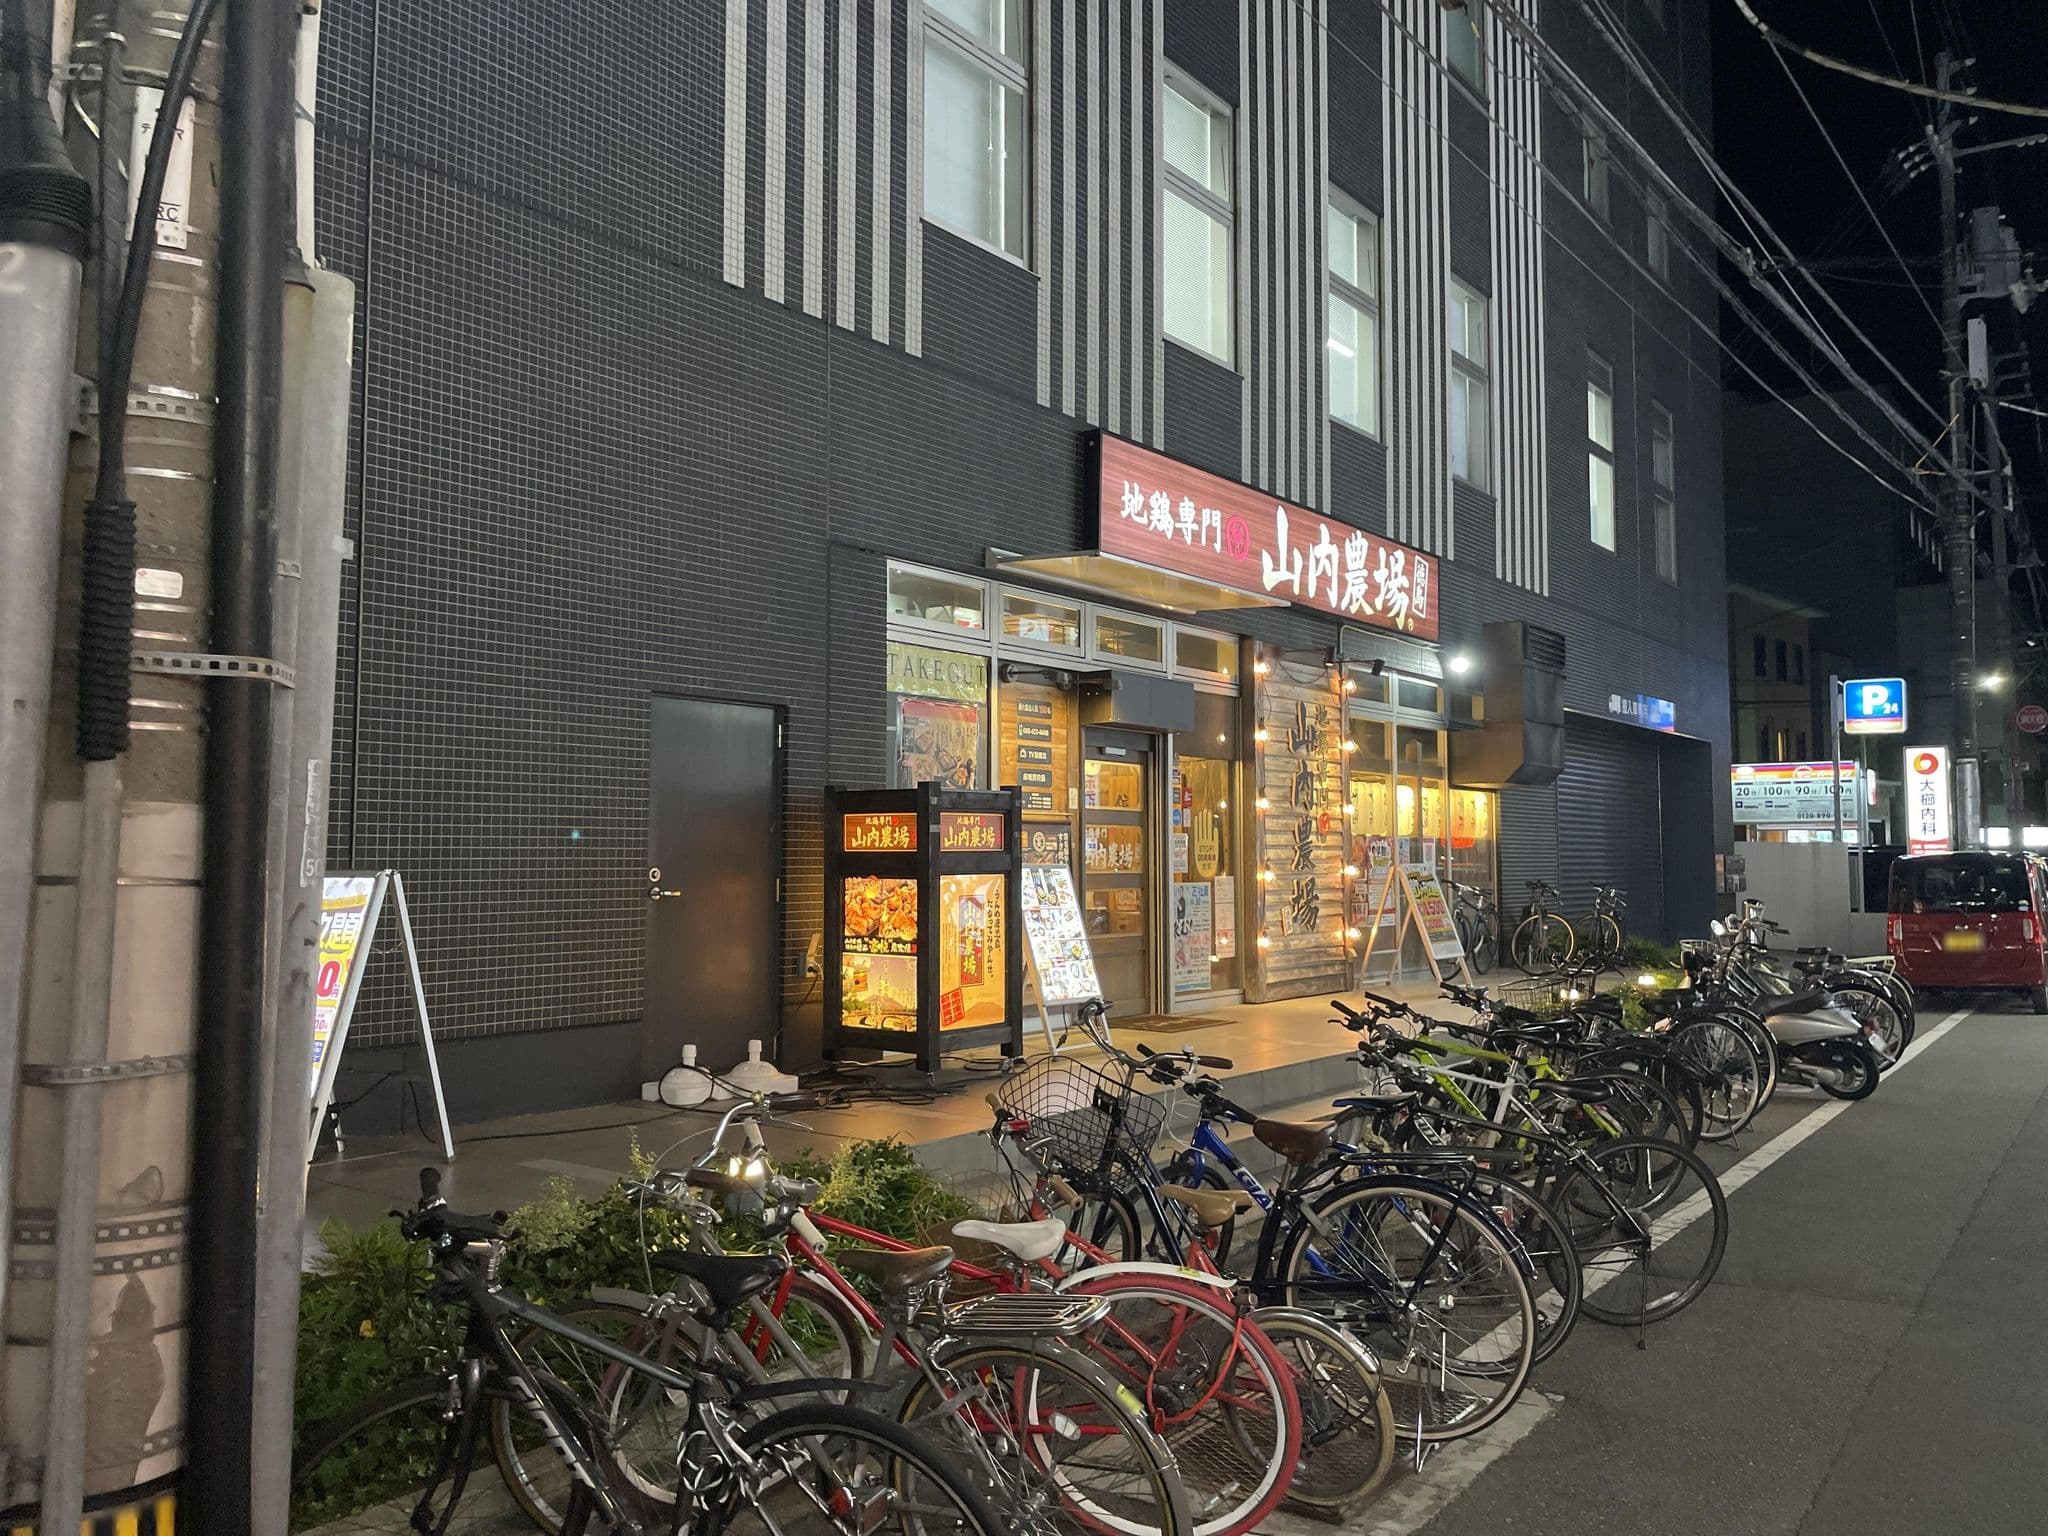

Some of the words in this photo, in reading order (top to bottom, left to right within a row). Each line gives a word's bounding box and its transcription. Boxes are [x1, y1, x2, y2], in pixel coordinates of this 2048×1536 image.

[1120, 480, 1222, 554] 地鶏専門
[1261, 505, 1410, 630] 山内農場
[888, 653, 985, 686] TAKEOUT
[1862, 685, 1889, 715] P
[1883, 702, 1899, 714] 24
[1287, 700, 1320, 934] 山内農場
[851, 825, 911, 849] 山内農場
[944, 825, 996, 849] 山内農場
[963, 900, 977, 976] 山内農場
